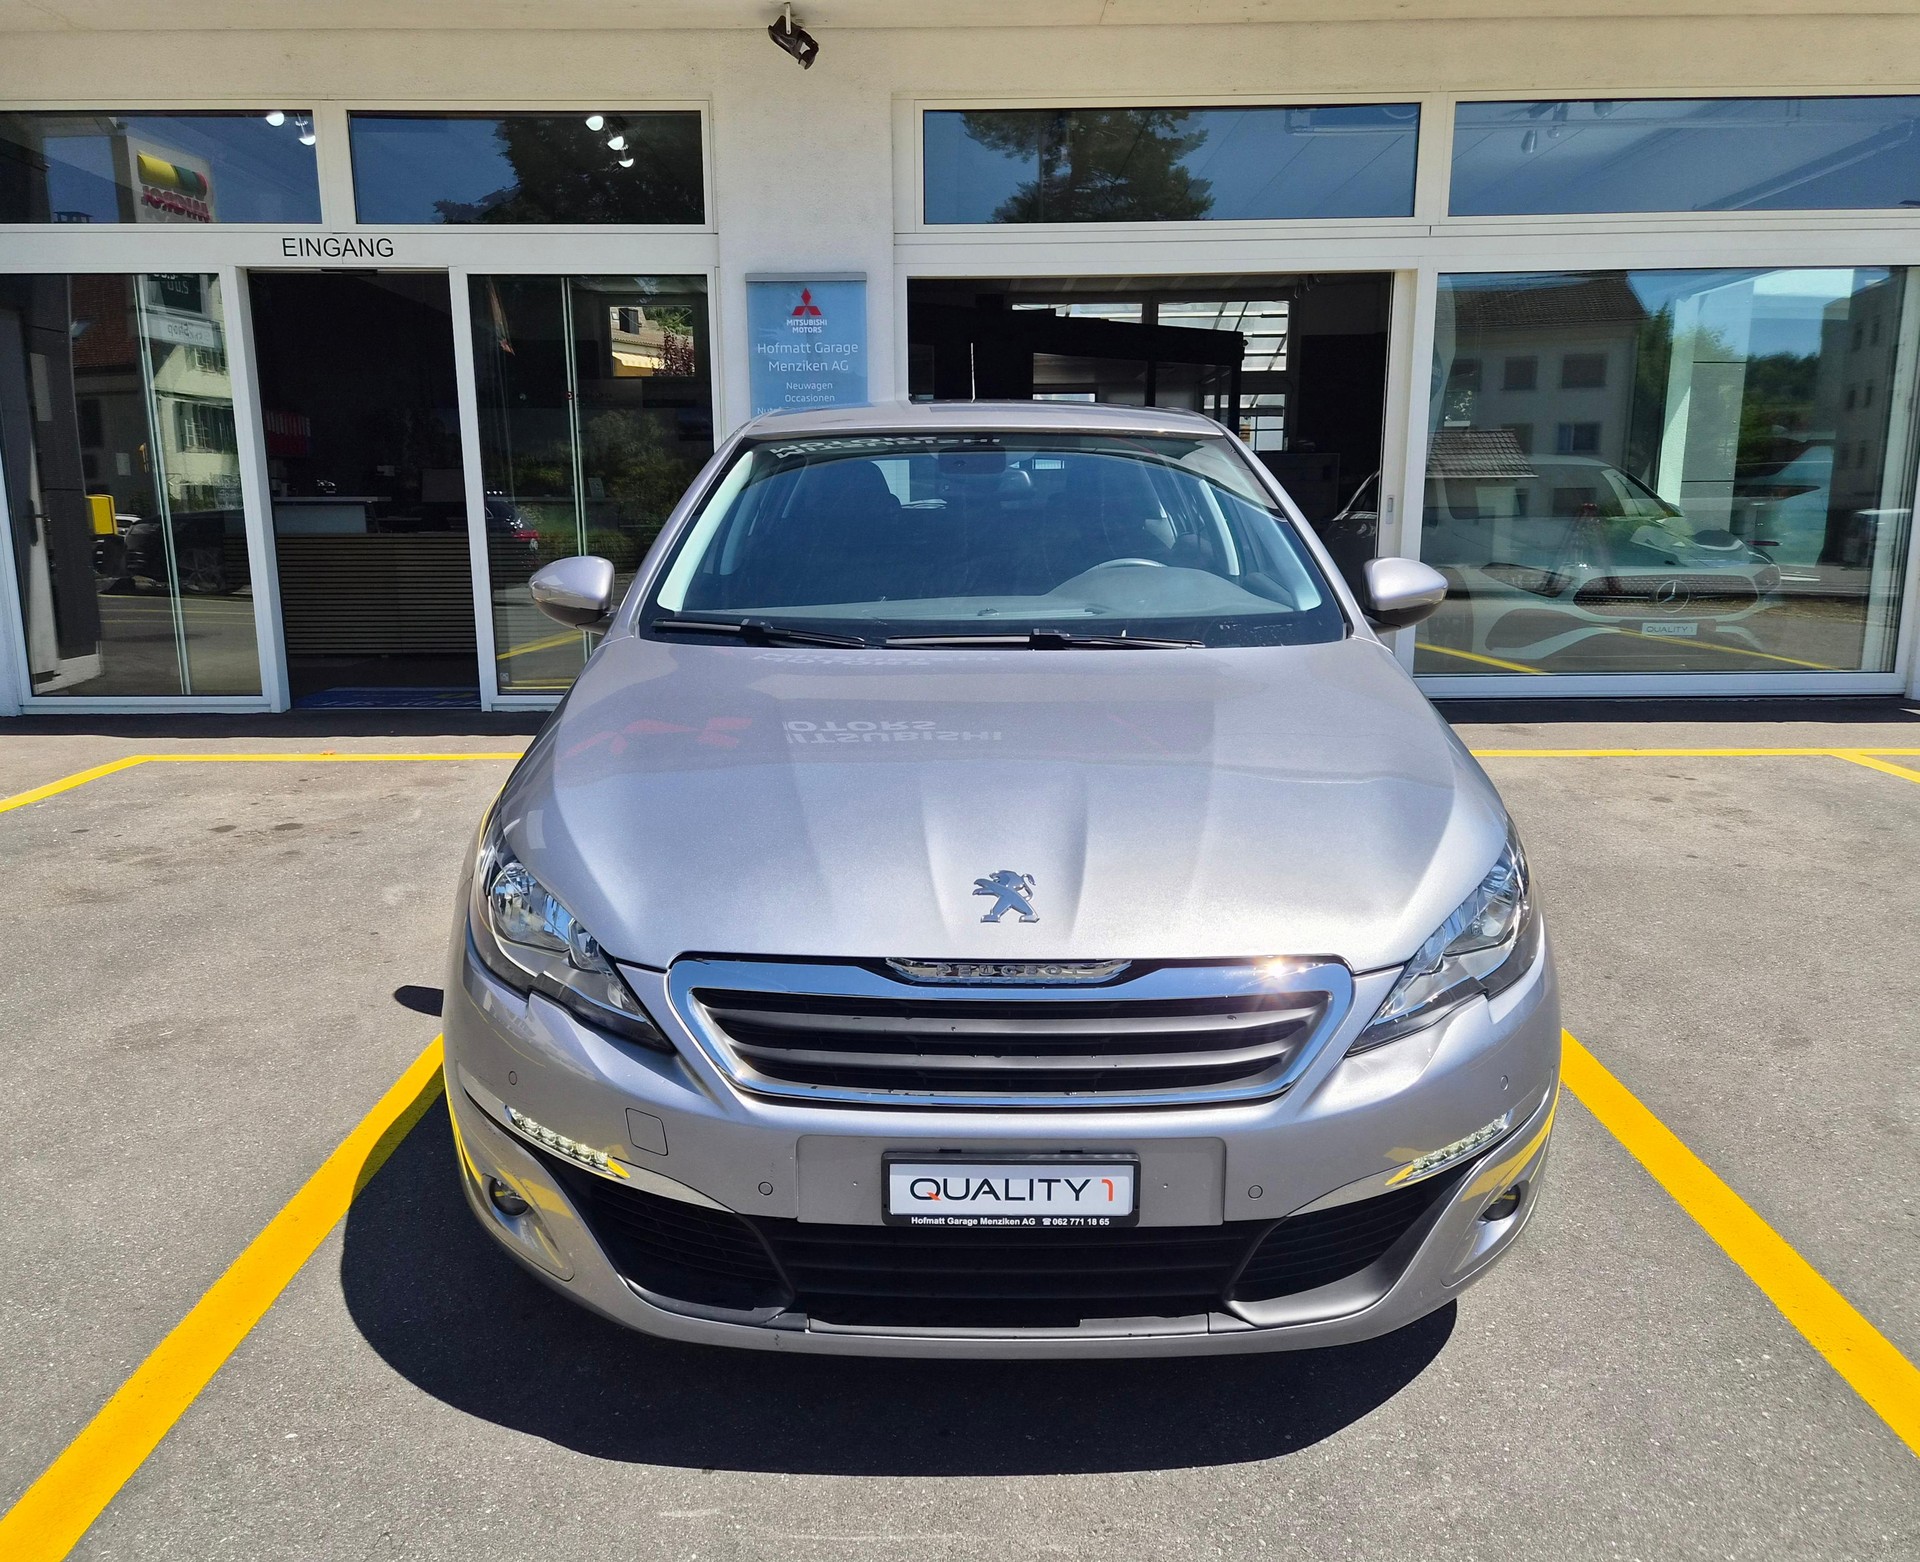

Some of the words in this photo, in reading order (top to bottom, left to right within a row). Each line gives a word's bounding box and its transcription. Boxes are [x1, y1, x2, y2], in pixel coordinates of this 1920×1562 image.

[282, 237, 394, 257] EINGANG
[792, 326, 822, 334] MOTORS
[757, 342, 811, 354] Hofmatt
[814, 342, 859, 355] Garage
[768, 360, 828, 372] Menziken
[831, 360, 849, 371] AG
[786, 382, 833, 391] Neuwagen
[784, 394, 835, 402] Occasionen
[909, 1177, 1092, 1201] QUALITY
[1101, 1178, 1114, 1202] 1
[911, 1217, 945, 1225] Hofmatt
[947, 1217, 978, 1226] Garage
[980, 1217, 1020, 1225] Menziken
[1022, 1217, 1036, 1226] AG
[1070, 1218, 1084, 1226] 771
[1087, 1218, 1097, 1226] 18
[1099, 1218, 1110, 1226] 65
